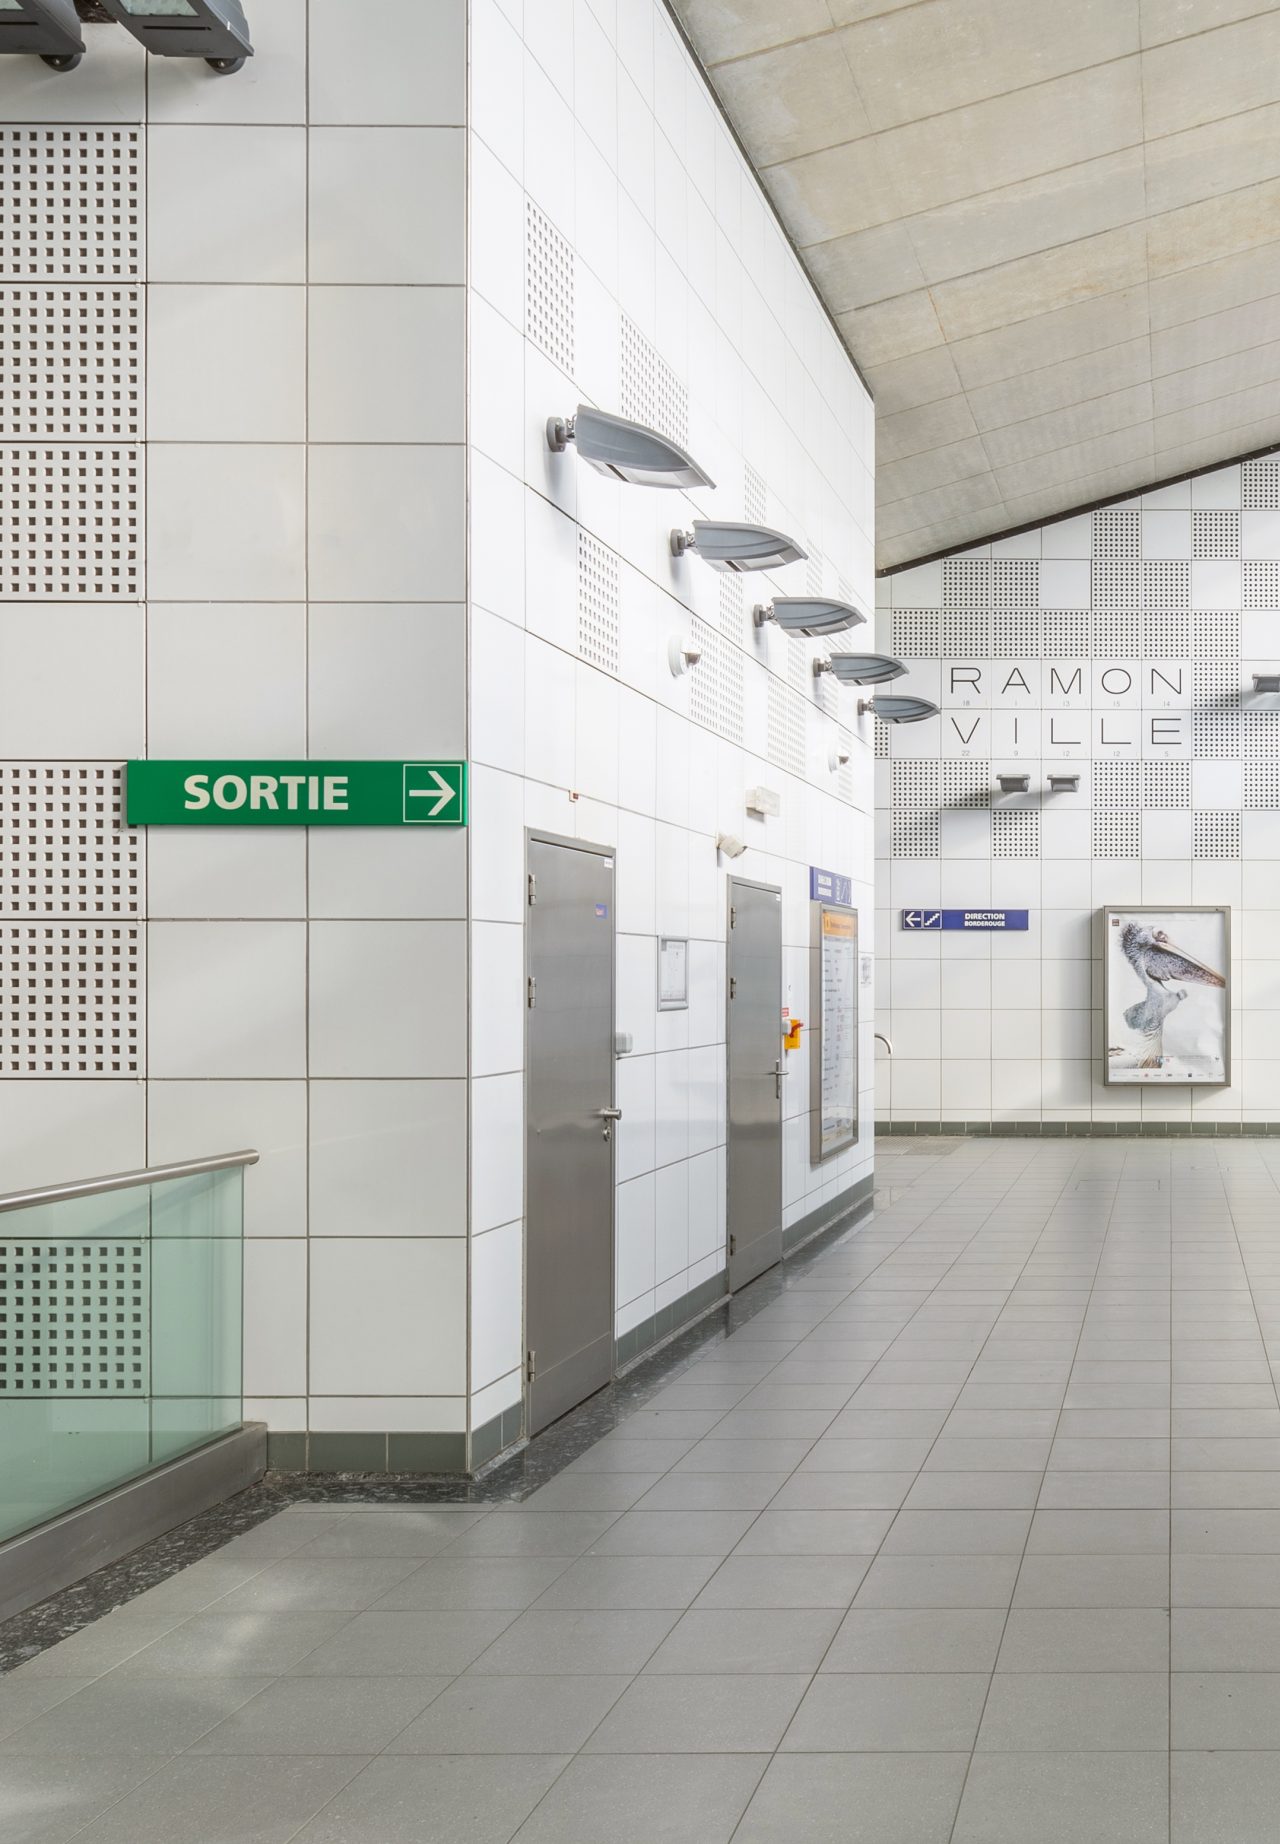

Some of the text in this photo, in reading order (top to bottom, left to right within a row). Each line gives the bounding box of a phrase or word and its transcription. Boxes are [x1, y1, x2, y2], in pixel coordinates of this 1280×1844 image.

[951, 667, 1182, 694] RAMON
[951, 717, 1182, 744] VILLE
[184, 775, 349, 810] SORTIE
[964, 912, 1005, 920] DIRECTION
